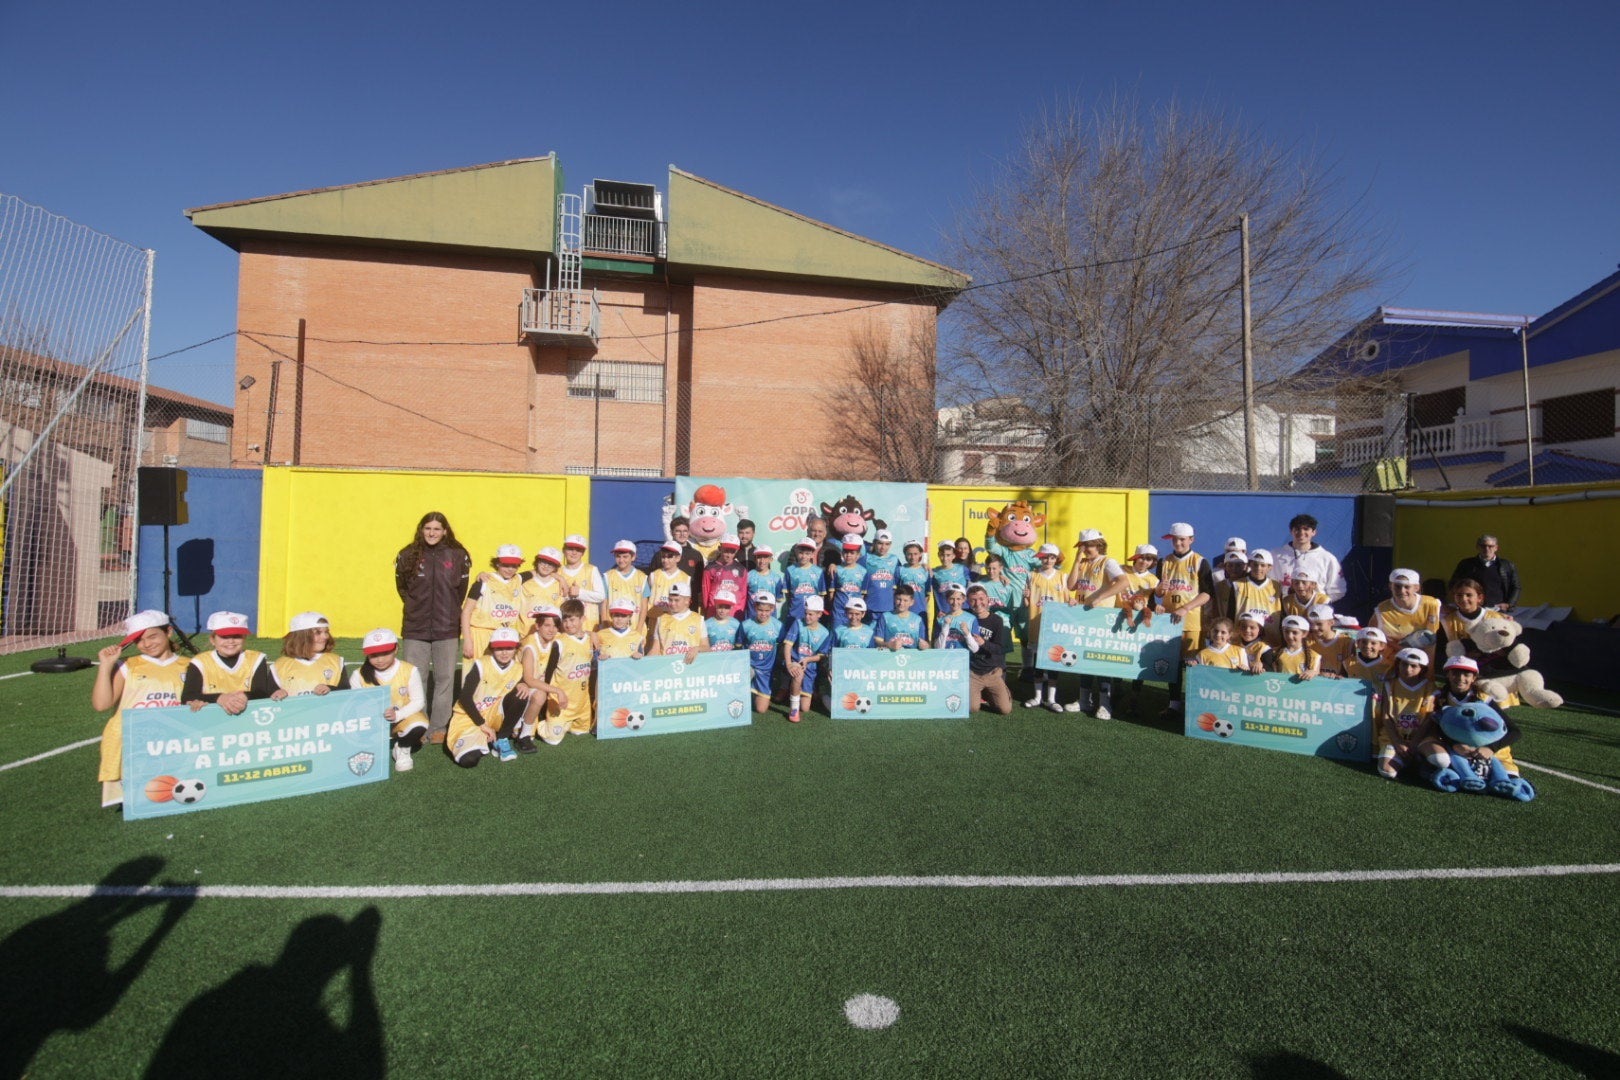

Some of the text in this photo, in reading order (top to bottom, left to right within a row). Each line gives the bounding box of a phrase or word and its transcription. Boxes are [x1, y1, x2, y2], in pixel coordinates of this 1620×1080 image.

[783, 506, 817, 516] COPA
[768, 515, 808, 531] COV
[1052, 623, 1085, 635] VALE
[1088, 627, 1114, 639] POR
[1117, 629, 1135, 641] UN
[1073, 637, 1083, 646] A
[1086, 638, 1102, 648] LA
[666, 647, 693, 655] COVA
[843, 670, 960, 679] VALE POR UN PASE
[612, 673, 741, 694] VALE POR UN PASE
[866, 682, 937, 691] A LA FINAL
[147, 692, 177, 700] COPA
[639, 688, 718, 704] A LA FINAL
[1199, 688, 1355, 715] VALE POR UN PASE
[655, 705, 704, 716] 11-12 ABRIL
[1227, 705, 1323, 726] A LA FINAL
[147, 717, 372, 756] VALE POR UN PASE
[1244, 722, 1303, 737] 11-12 ABRIL
[195, 754, 211, 769] A
[219, 750, 251, 767] LA
[257, 740, 332, 761] FINAL
[223, 764, 307, 783] 11-12 ABRIL
